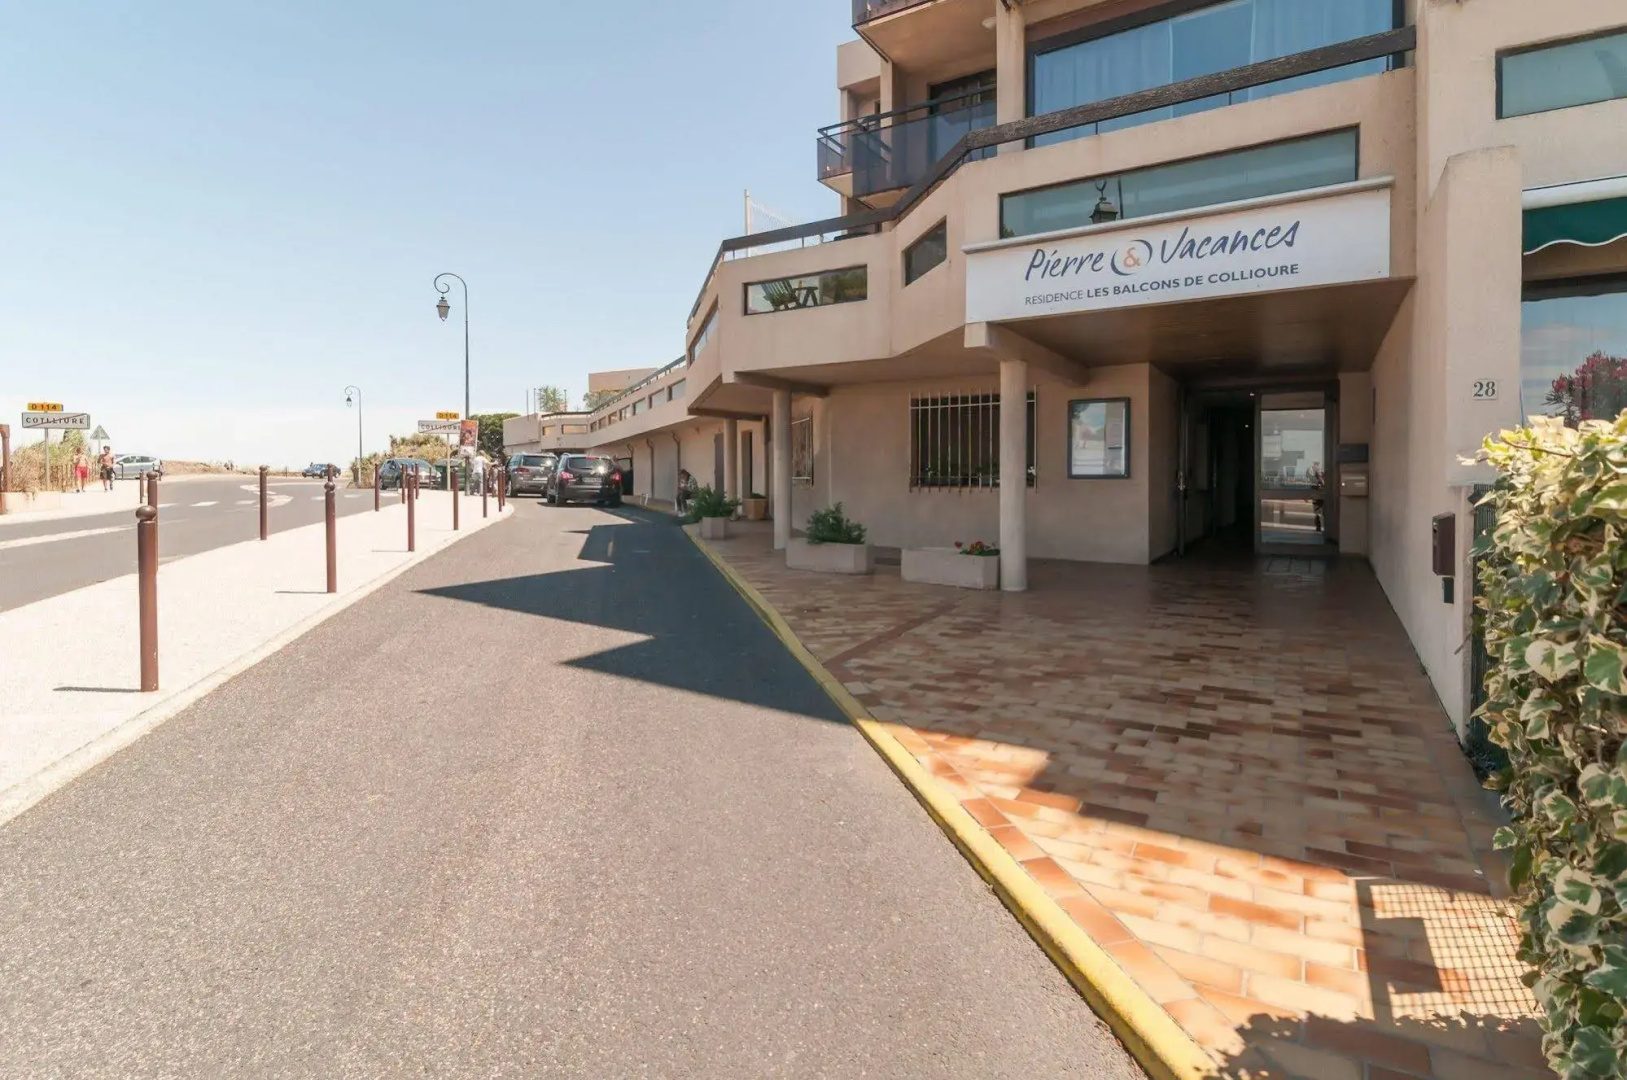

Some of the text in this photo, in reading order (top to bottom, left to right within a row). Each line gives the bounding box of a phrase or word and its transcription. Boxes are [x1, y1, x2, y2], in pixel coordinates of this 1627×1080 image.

[1025, 248, 1105, 281] Pierre
[1161, 220, 1301, 264] Vacances
[1025, 263, 1300, 305] RESIDENCE LES BALCONS DE COLLIOURE
[1473, 380, 1496, 398] 28
[25, 416, 85, 425] COLLIOURE
